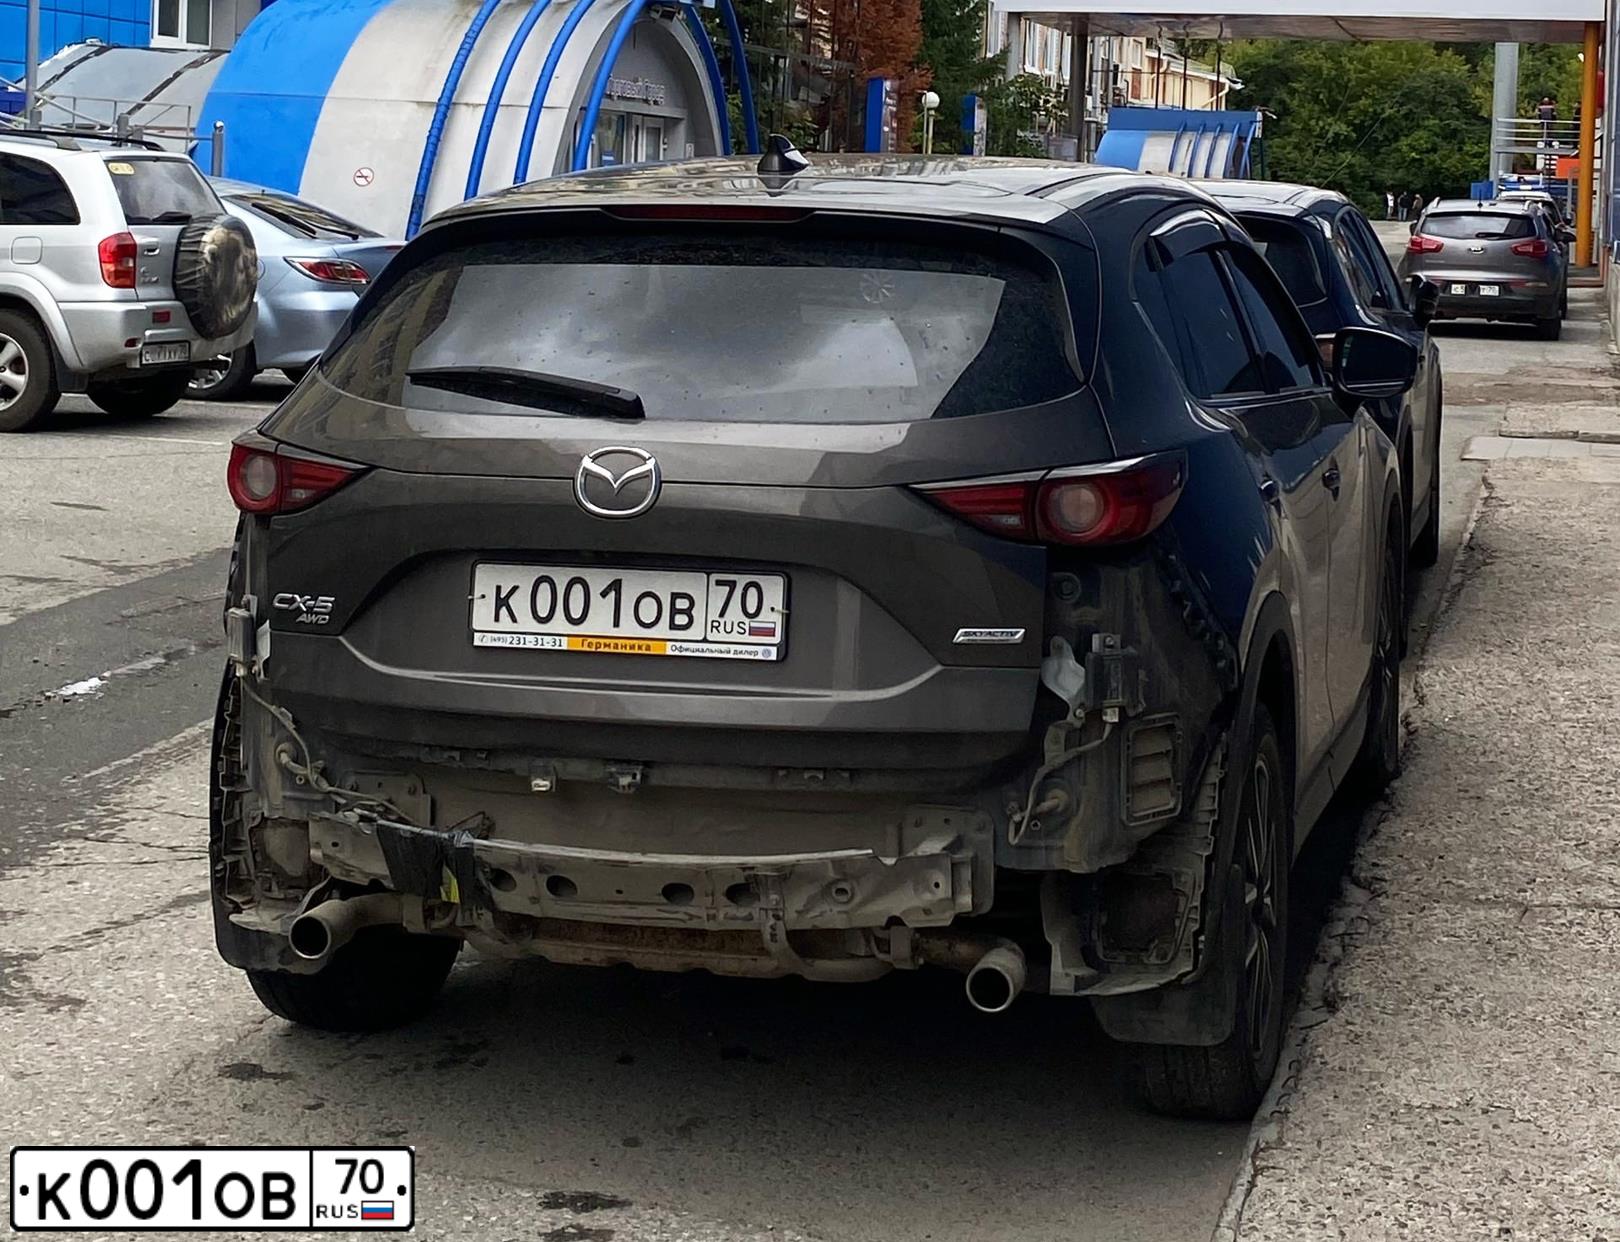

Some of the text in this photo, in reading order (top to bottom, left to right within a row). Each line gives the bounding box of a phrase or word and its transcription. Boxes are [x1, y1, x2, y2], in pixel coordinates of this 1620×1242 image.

[272, 593, 336, 614] CX-5
[493, 575, 764, 631] К001ОВ 70
[296, 613, 330, 624] AWD
[710, 619, 747, 635] RUS
[508, 635, 563, 648] 231-31-31
[580, 638, 652, 653] Германика
[670, 644, 731, 655] Официальный
[733, 648, 759, 657] дилер
